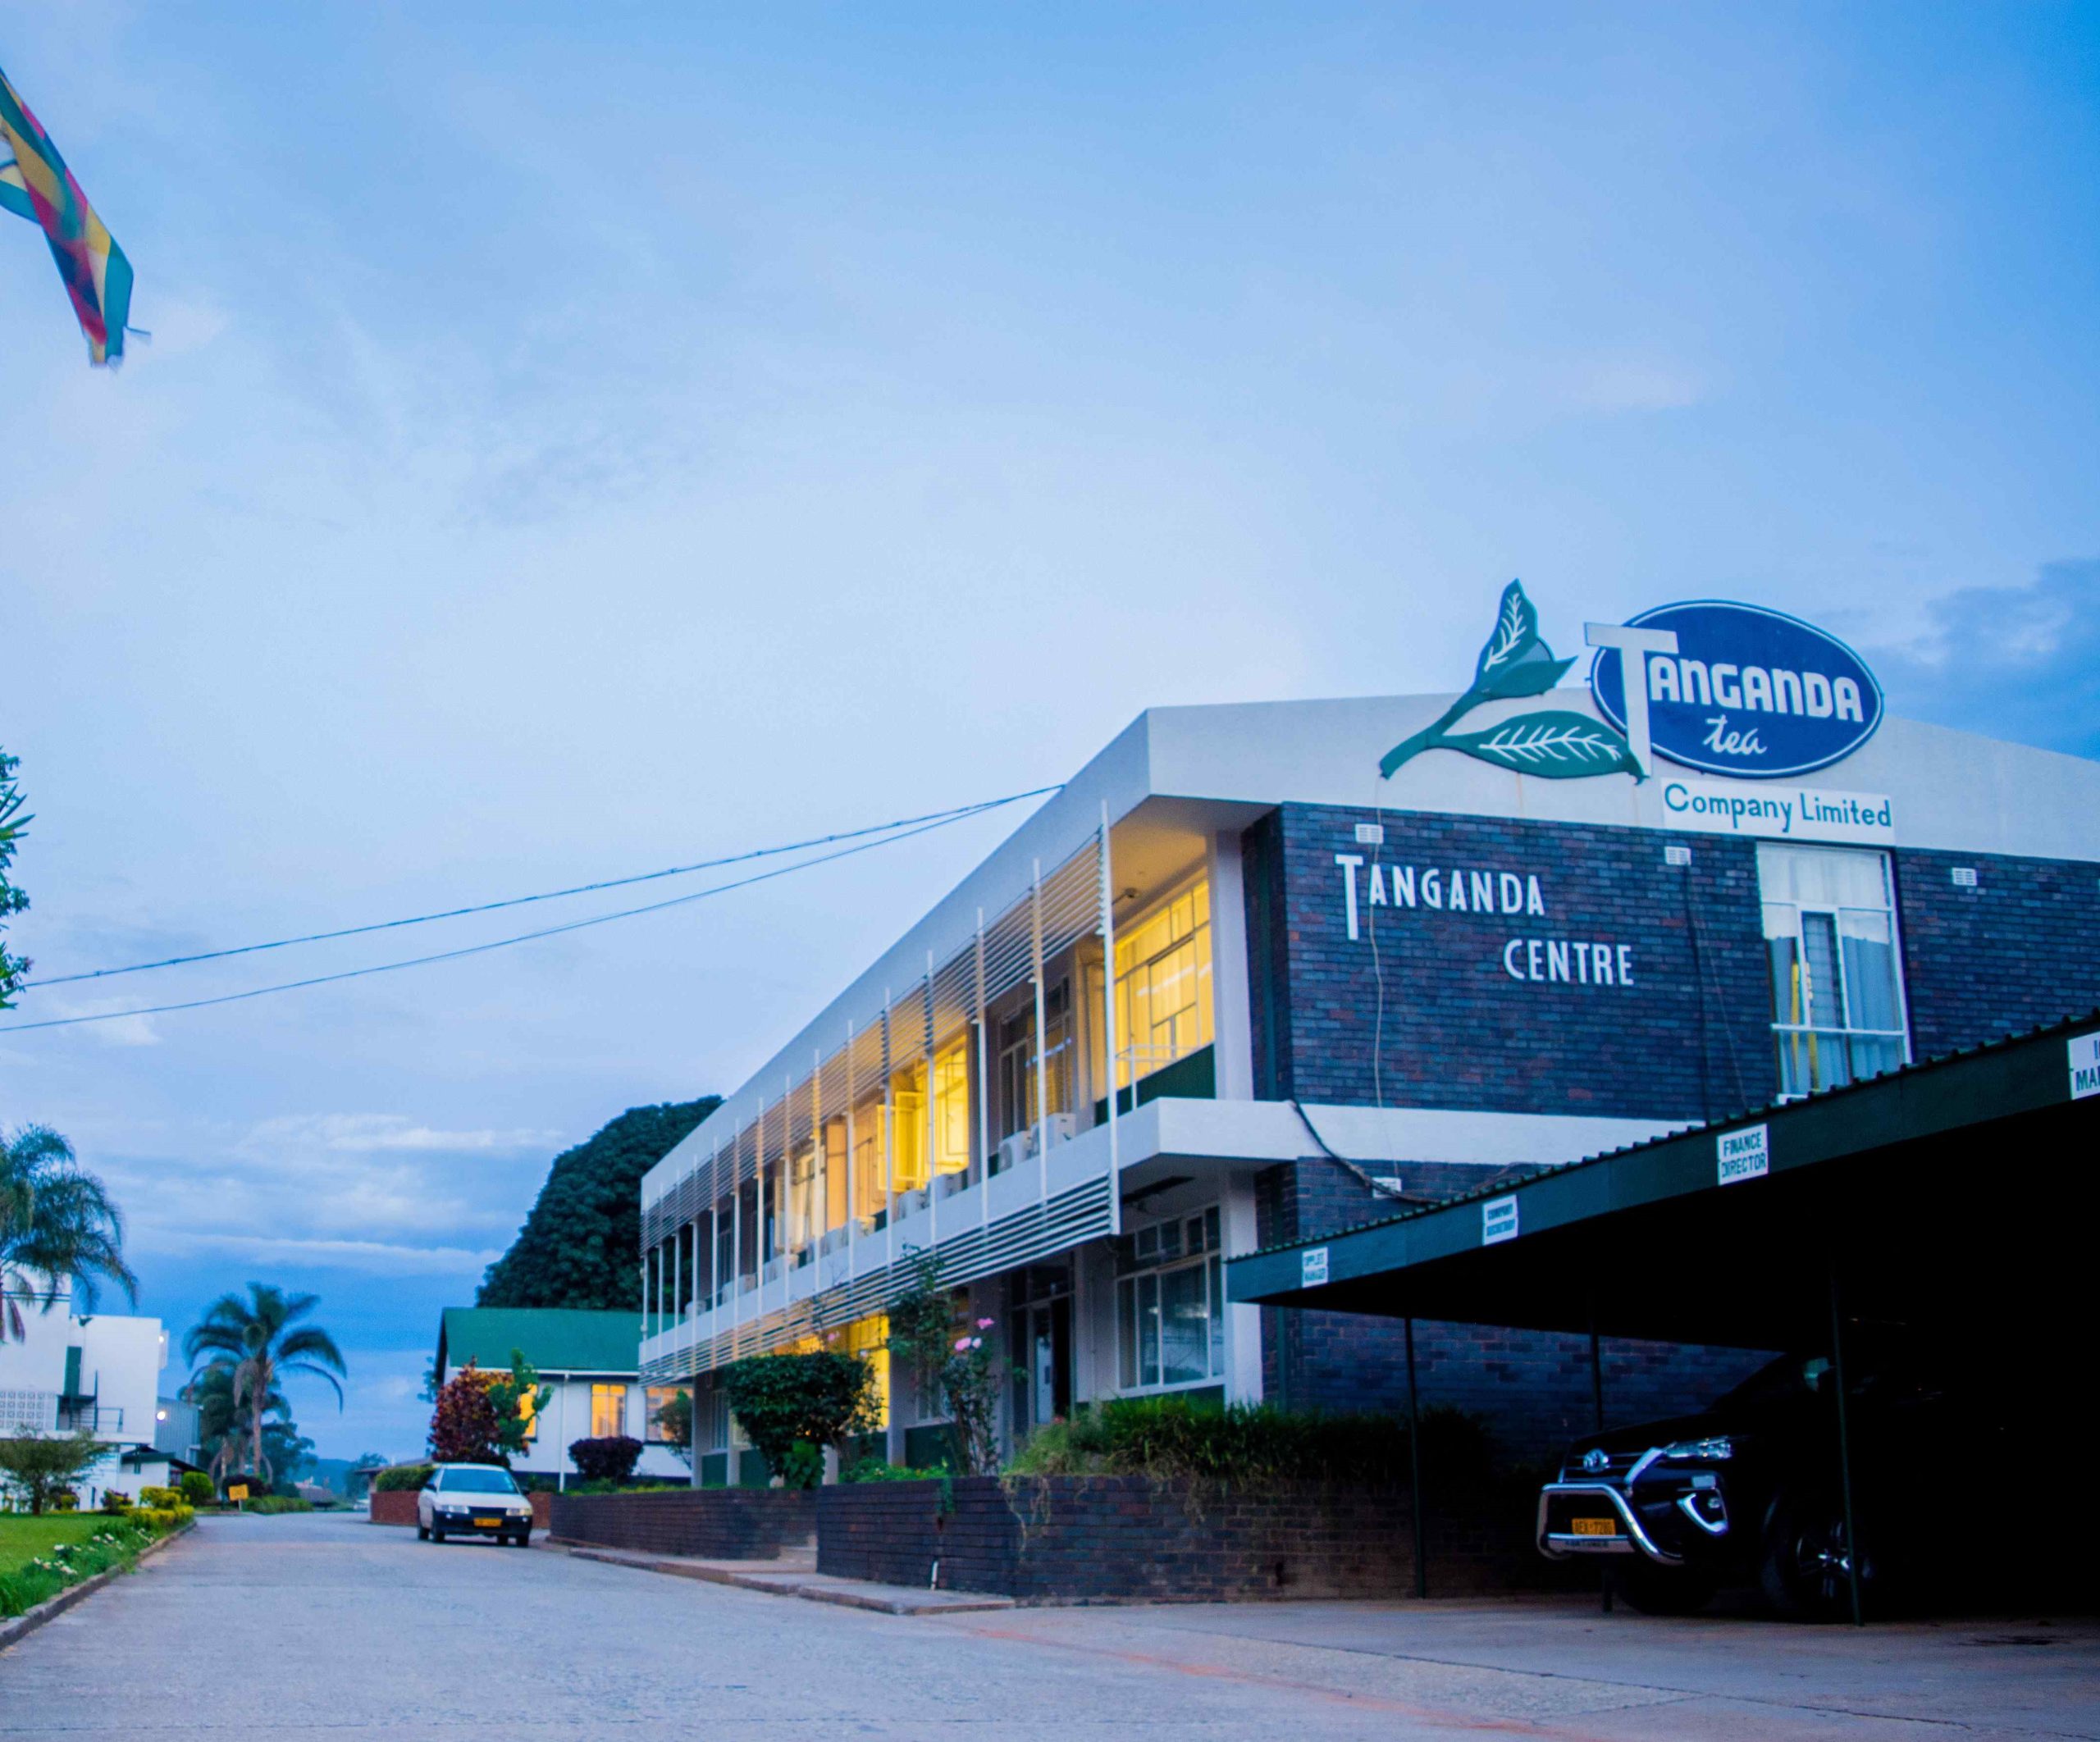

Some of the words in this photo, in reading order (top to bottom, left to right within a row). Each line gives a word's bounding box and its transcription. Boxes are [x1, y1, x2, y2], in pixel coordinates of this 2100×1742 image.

[1584, 622, 1864, 777] TANGANDA
[1702, 714, 1768, 755] tea
[1664, 782, 1792, 833] Company
[1800, 791, 1892, 828] Limited
[1335, 854, 1545, 941] TANGANDA
[1503, 939, 1634, 986] CENTRE
